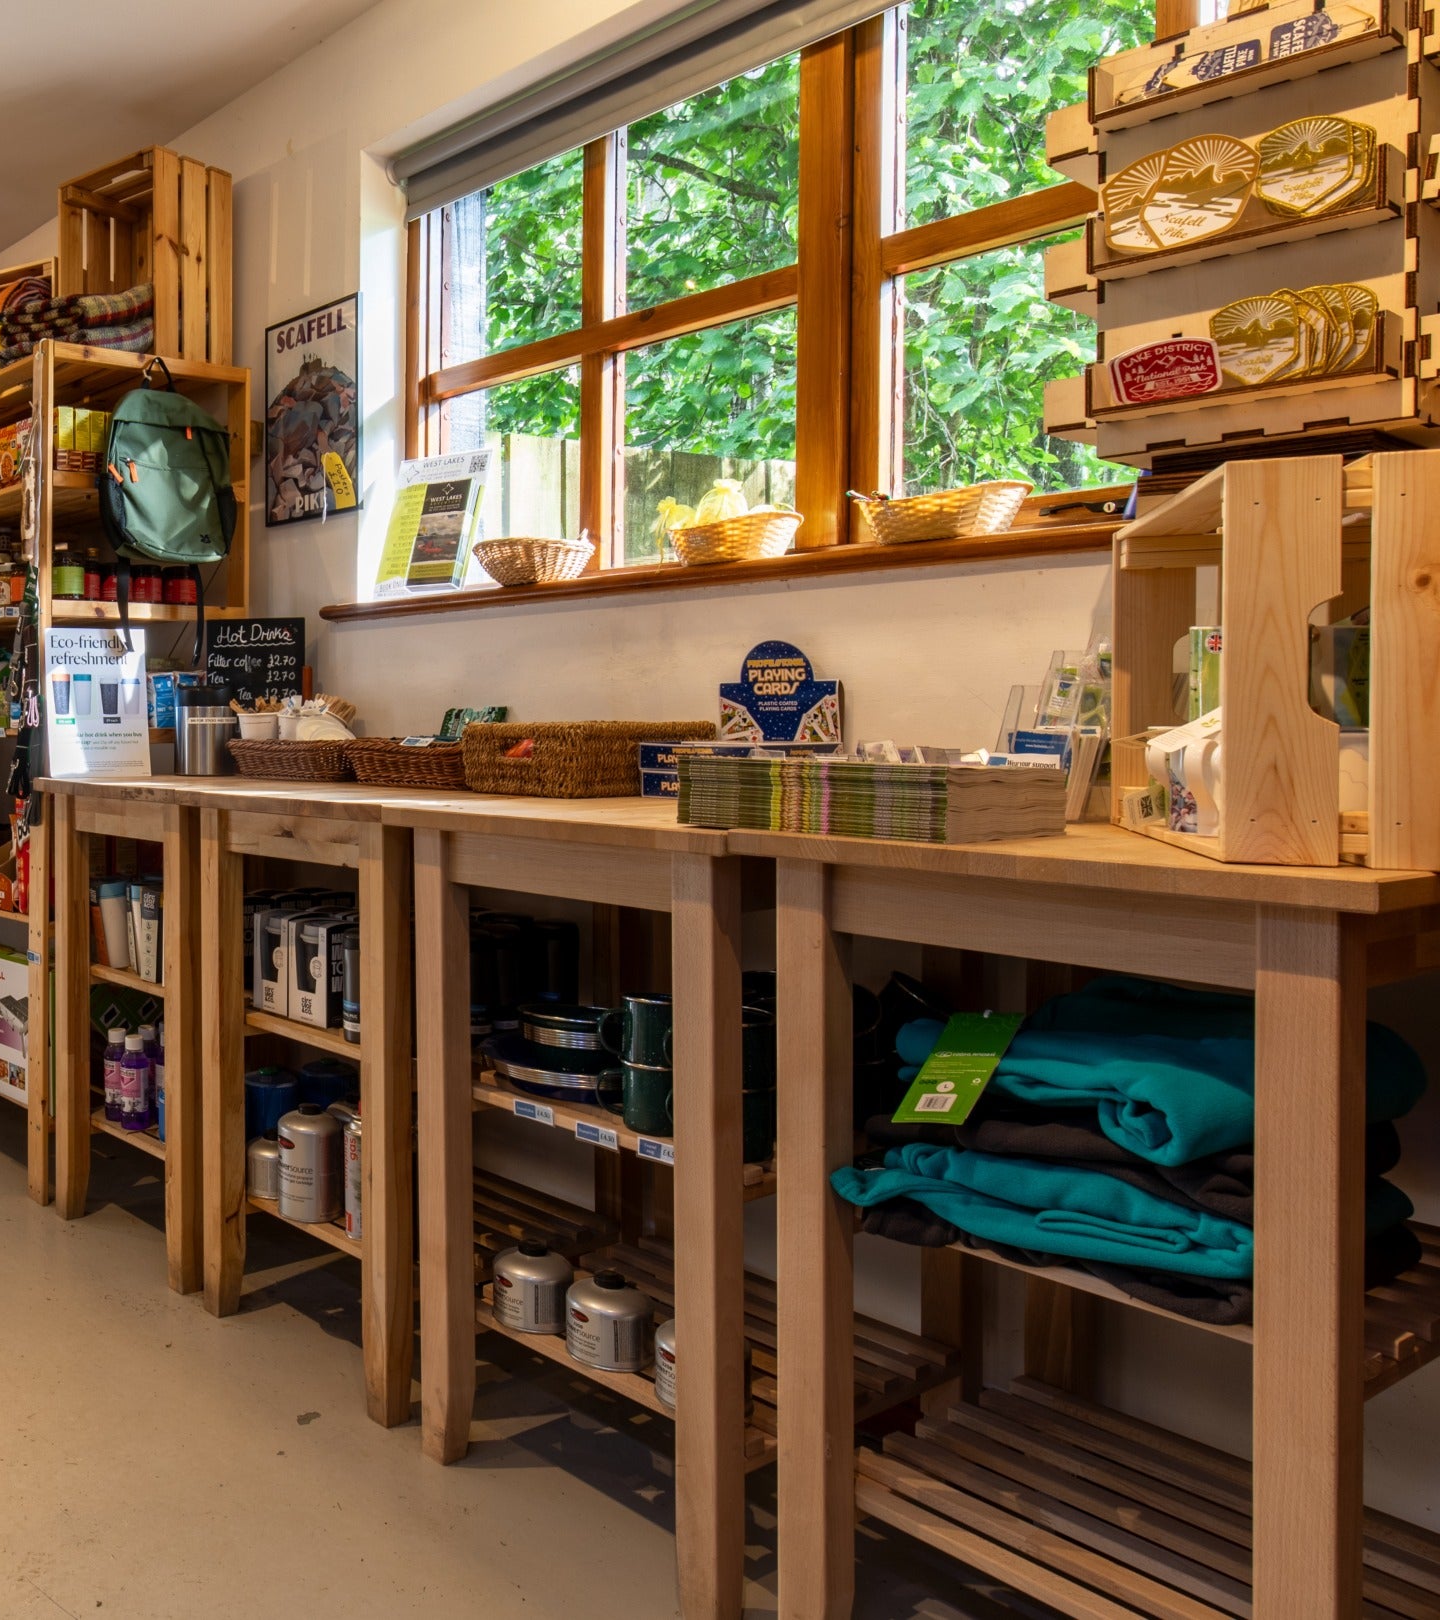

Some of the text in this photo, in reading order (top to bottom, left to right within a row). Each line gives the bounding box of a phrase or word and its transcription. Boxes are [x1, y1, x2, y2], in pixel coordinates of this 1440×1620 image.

[1292, 19, 1306, 53] SCAFE
[1222, 45, 1238, 75] CAFELL
[1160, 212, 1208, 227] Scafell
[1160, 227, 1188, 239] Pike
[276, 308, 347, 354] SCAFELL
[1122, 343, 1211, 368] LAKE DISTRICT
[1133, 363, 1208, 383] National Park
[423, 456, 465, 469] WEST LAKES
[294, 493, 328, 514] PIKE
[216, 623, 294, 645] Hot Drinks
[50, 634, 127, 652] Eco-friendly
[51, 651, 128, 666] refreshment
[207, 653, 297, 673] Filter coffee £2.70
[265, 670, 296, 684] £2.70
[748, 667, 807, 683] PLAYING
[236, 687, 254, 700] Tea
[753, 682, 801, 696] CARDS
[1032, 761, 1057, 770] support
[349, 1137, 359, 1162] gas
[662, 1149, 674, 1159] £4.5
